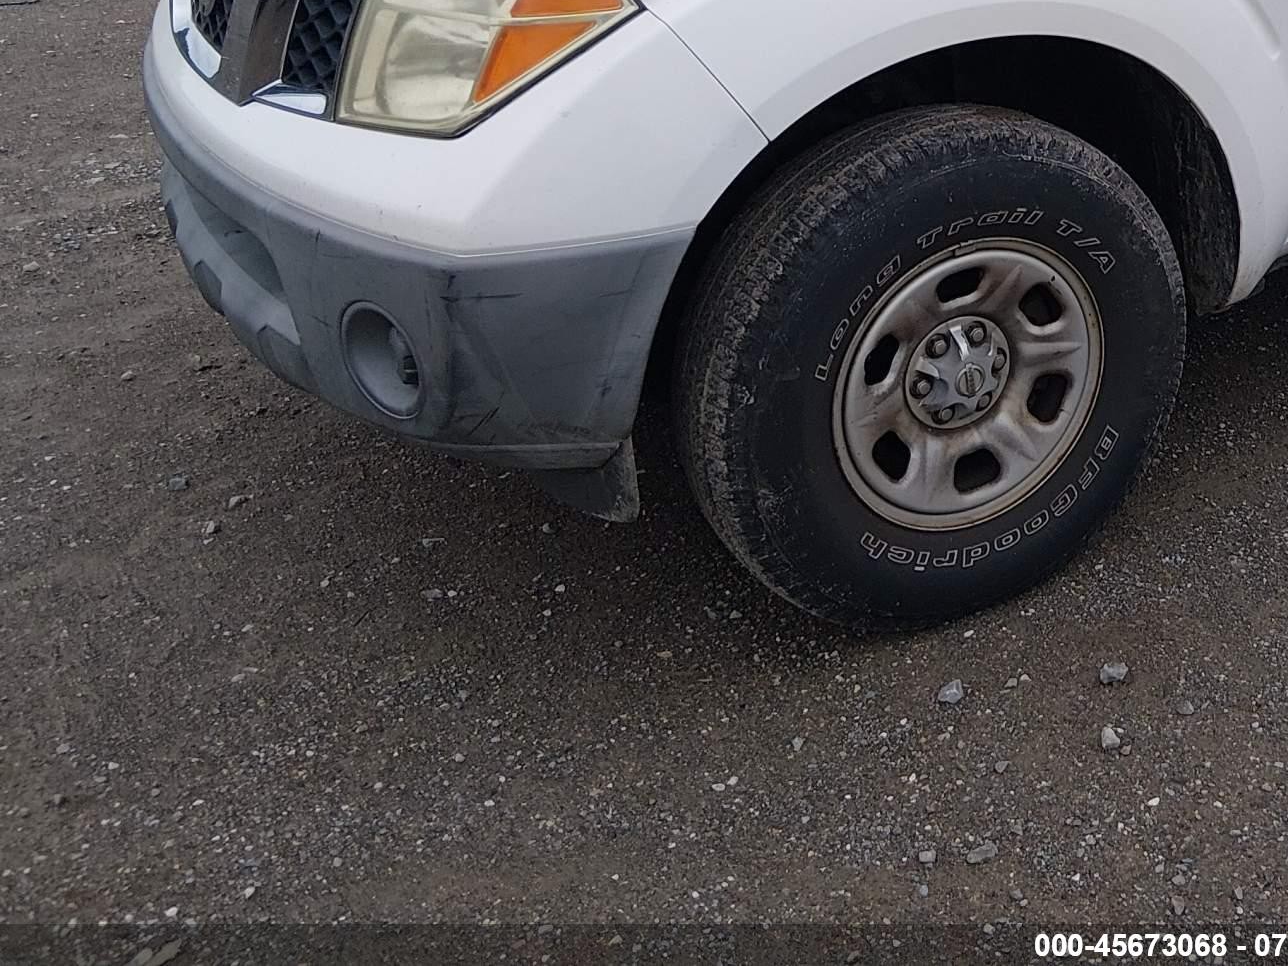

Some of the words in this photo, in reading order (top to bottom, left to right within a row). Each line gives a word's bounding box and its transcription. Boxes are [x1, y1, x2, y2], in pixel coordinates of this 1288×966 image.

[814, 254, 902, 382] Long
[916, 207, 1044, 249] Trail
[1056, 219, 1116, 275] T/A
[859, 425, 1120, 572] BFGoodrich
